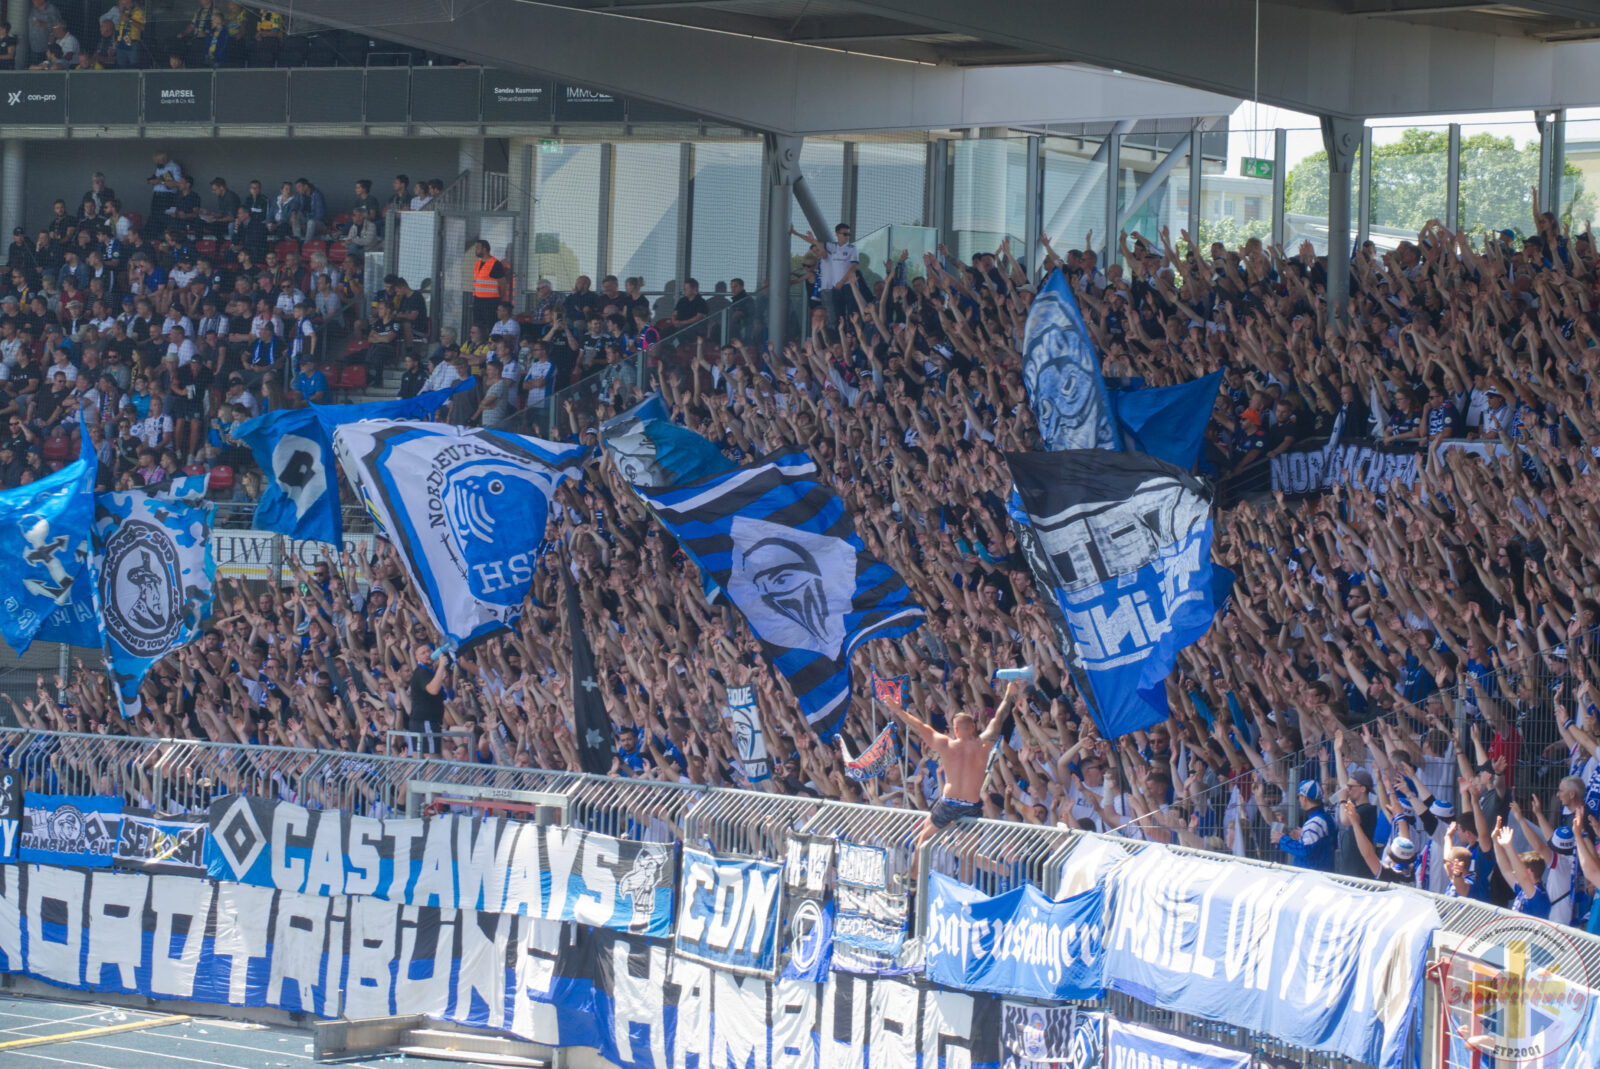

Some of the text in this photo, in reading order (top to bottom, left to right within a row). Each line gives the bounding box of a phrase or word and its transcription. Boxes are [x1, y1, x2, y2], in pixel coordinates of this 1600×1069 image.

[27, 94, 57, 102] con-pro
[20, 832, 87, 854] HAMBURG
[271, 799, 620, 928] CASTAWAYS
[926, 894, 1100, 985] Hafensänger
[613, 939, 976, 1069] HAMBURG
